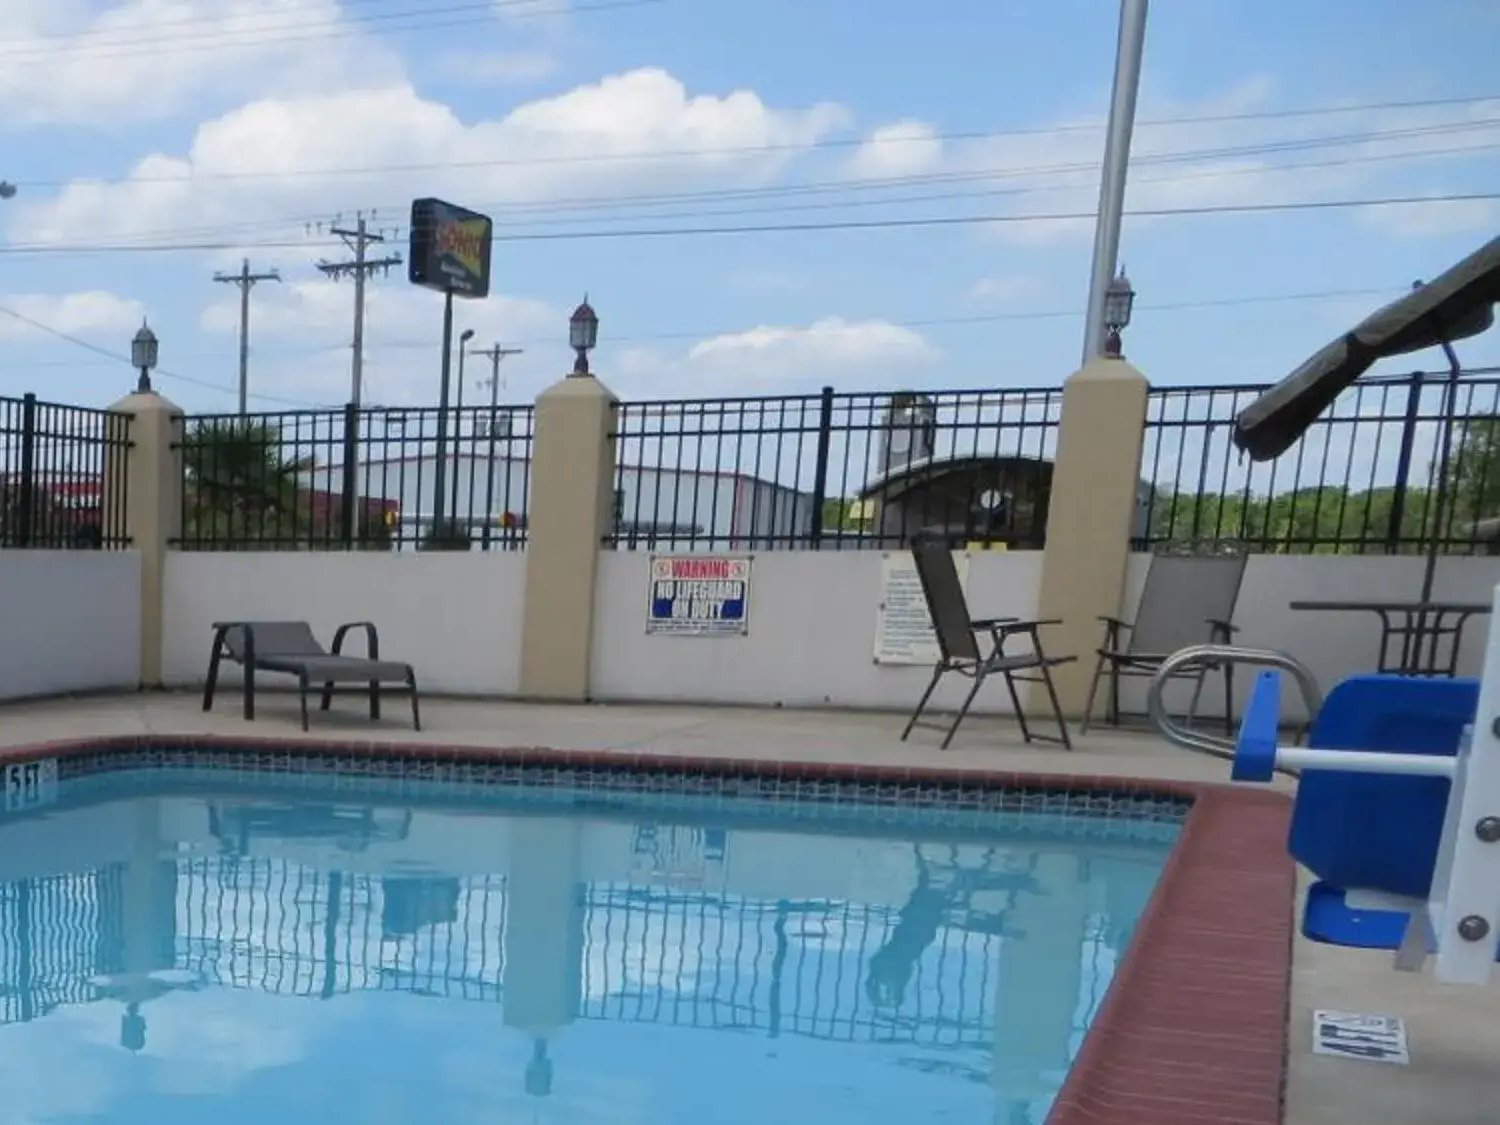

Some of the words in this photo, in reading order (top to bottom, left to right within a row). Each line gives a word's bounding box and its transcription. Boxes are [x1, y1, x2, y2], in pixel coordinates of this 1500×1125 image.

[672, 559, 729, 578] WARNING
[657, 581, 674, 600] NO
[677, 581, 742, 600] LIFEGUARD
[672, 600, 690, 619] ON
[692, 600, 724, 619] DUTY
